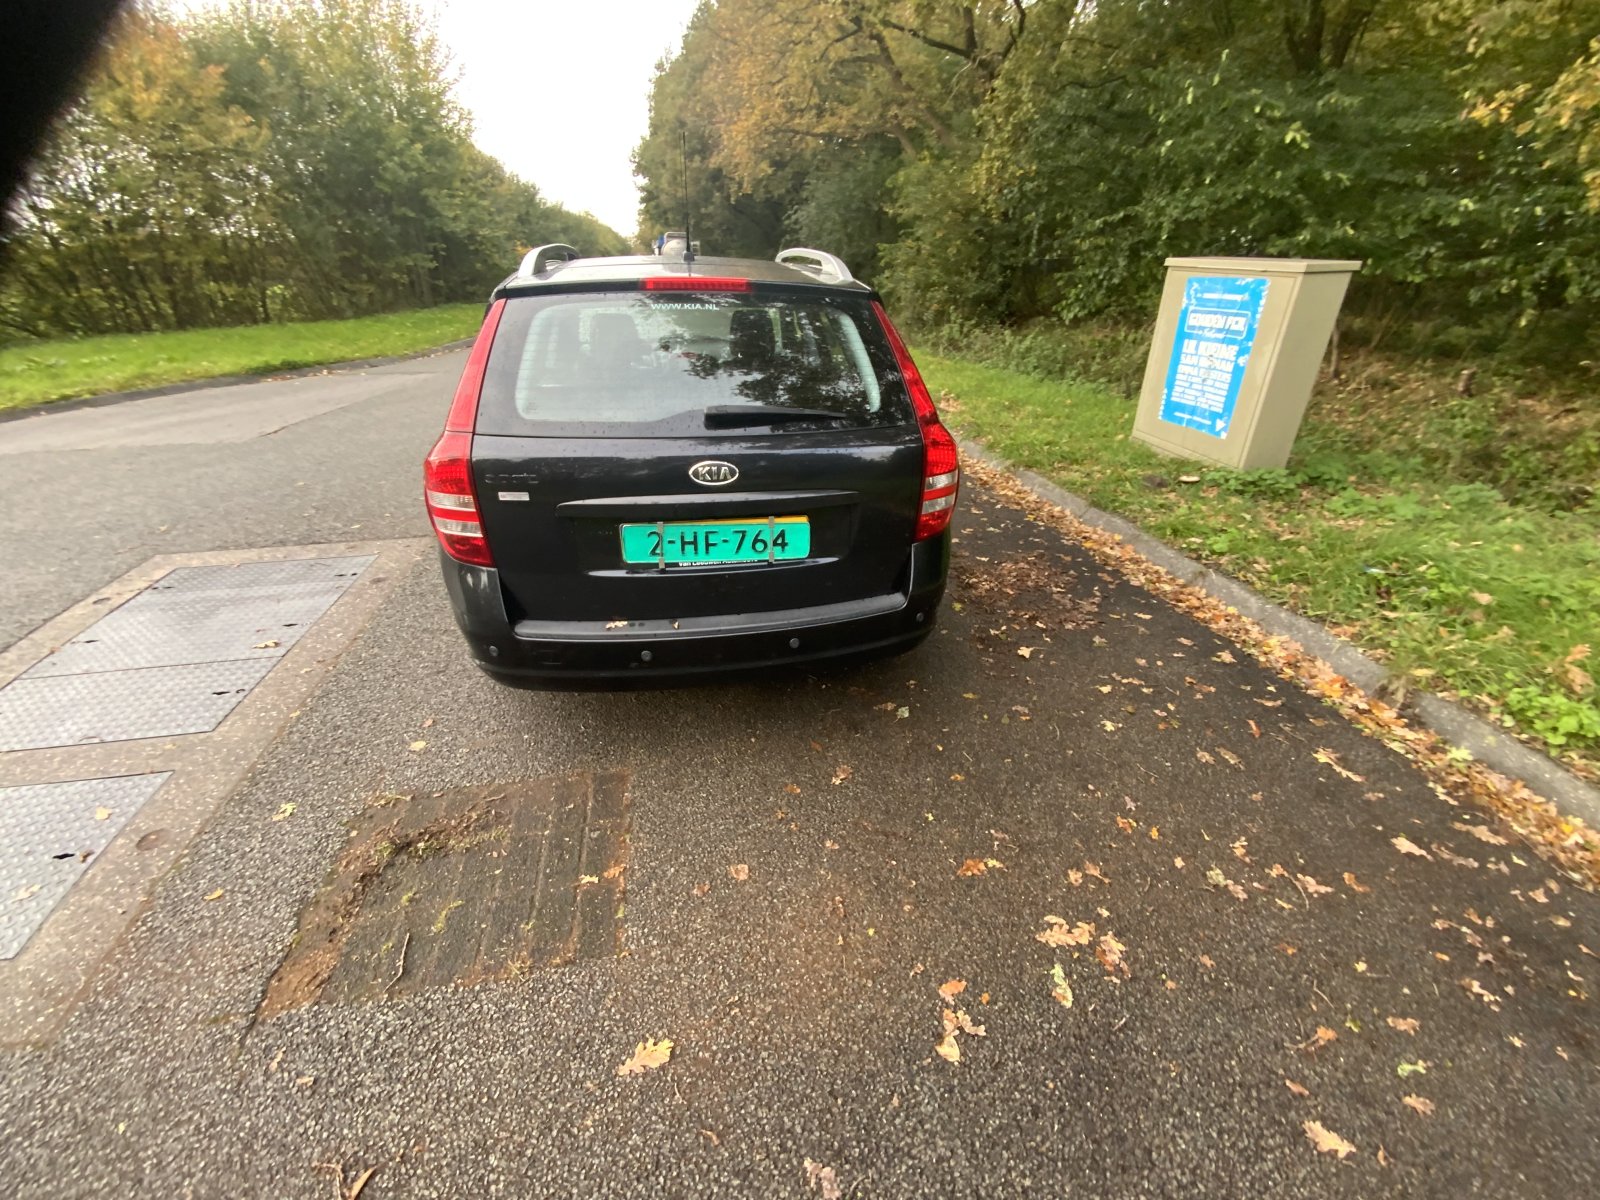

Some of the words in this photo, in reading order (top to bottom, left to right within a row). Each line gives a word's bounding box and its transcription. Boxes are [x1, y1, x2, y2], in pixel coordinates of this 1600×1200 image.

[651, 303, 720, 311] WWW.KIA.NL
[697, 466, 731, 480] KIA
[647, 529, 788, 557] 2-HF-764
